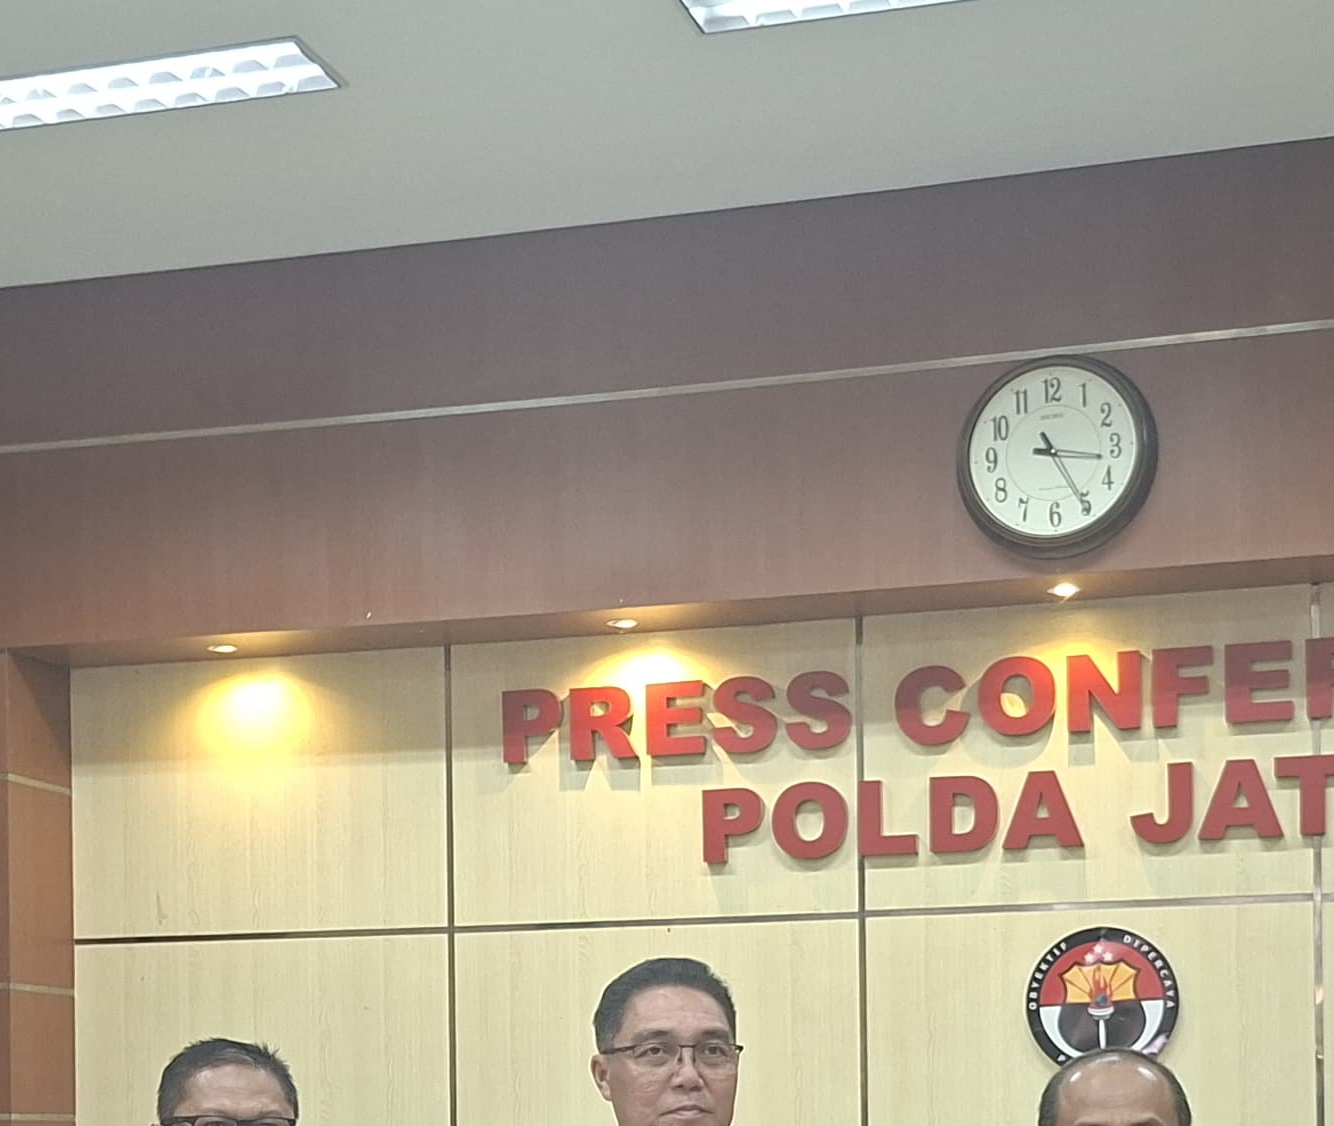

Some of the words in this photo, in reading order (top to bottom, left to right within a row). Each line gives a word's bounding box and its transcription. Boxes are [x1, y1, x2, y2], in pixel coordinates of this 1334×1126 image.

[1014, 389, 1028, 415] 11
[1043, 377, 1061, 403] 12
[1080, 382, 1087, 408] 1
[1100, 402, 1112, 427] 2
[991, 415, 1009, 441] 10
[1109, 433, 1122, 458] 3
[985, 447, 998, 473] 9
[995, 478, 1007, 503] 8
[1102, 465, 1114, 490] 4
[1018, 498, 1028, 523] 7
[1049, 502, 1061, 527] 6
[503, 672, 850, 765] PRESS
[701, 770, 1083, 864] POLDA
[1029, 942, 1067, 1010] OBYEKTIF
[1123, 935, 1176, 1008] DIPERCAYA
